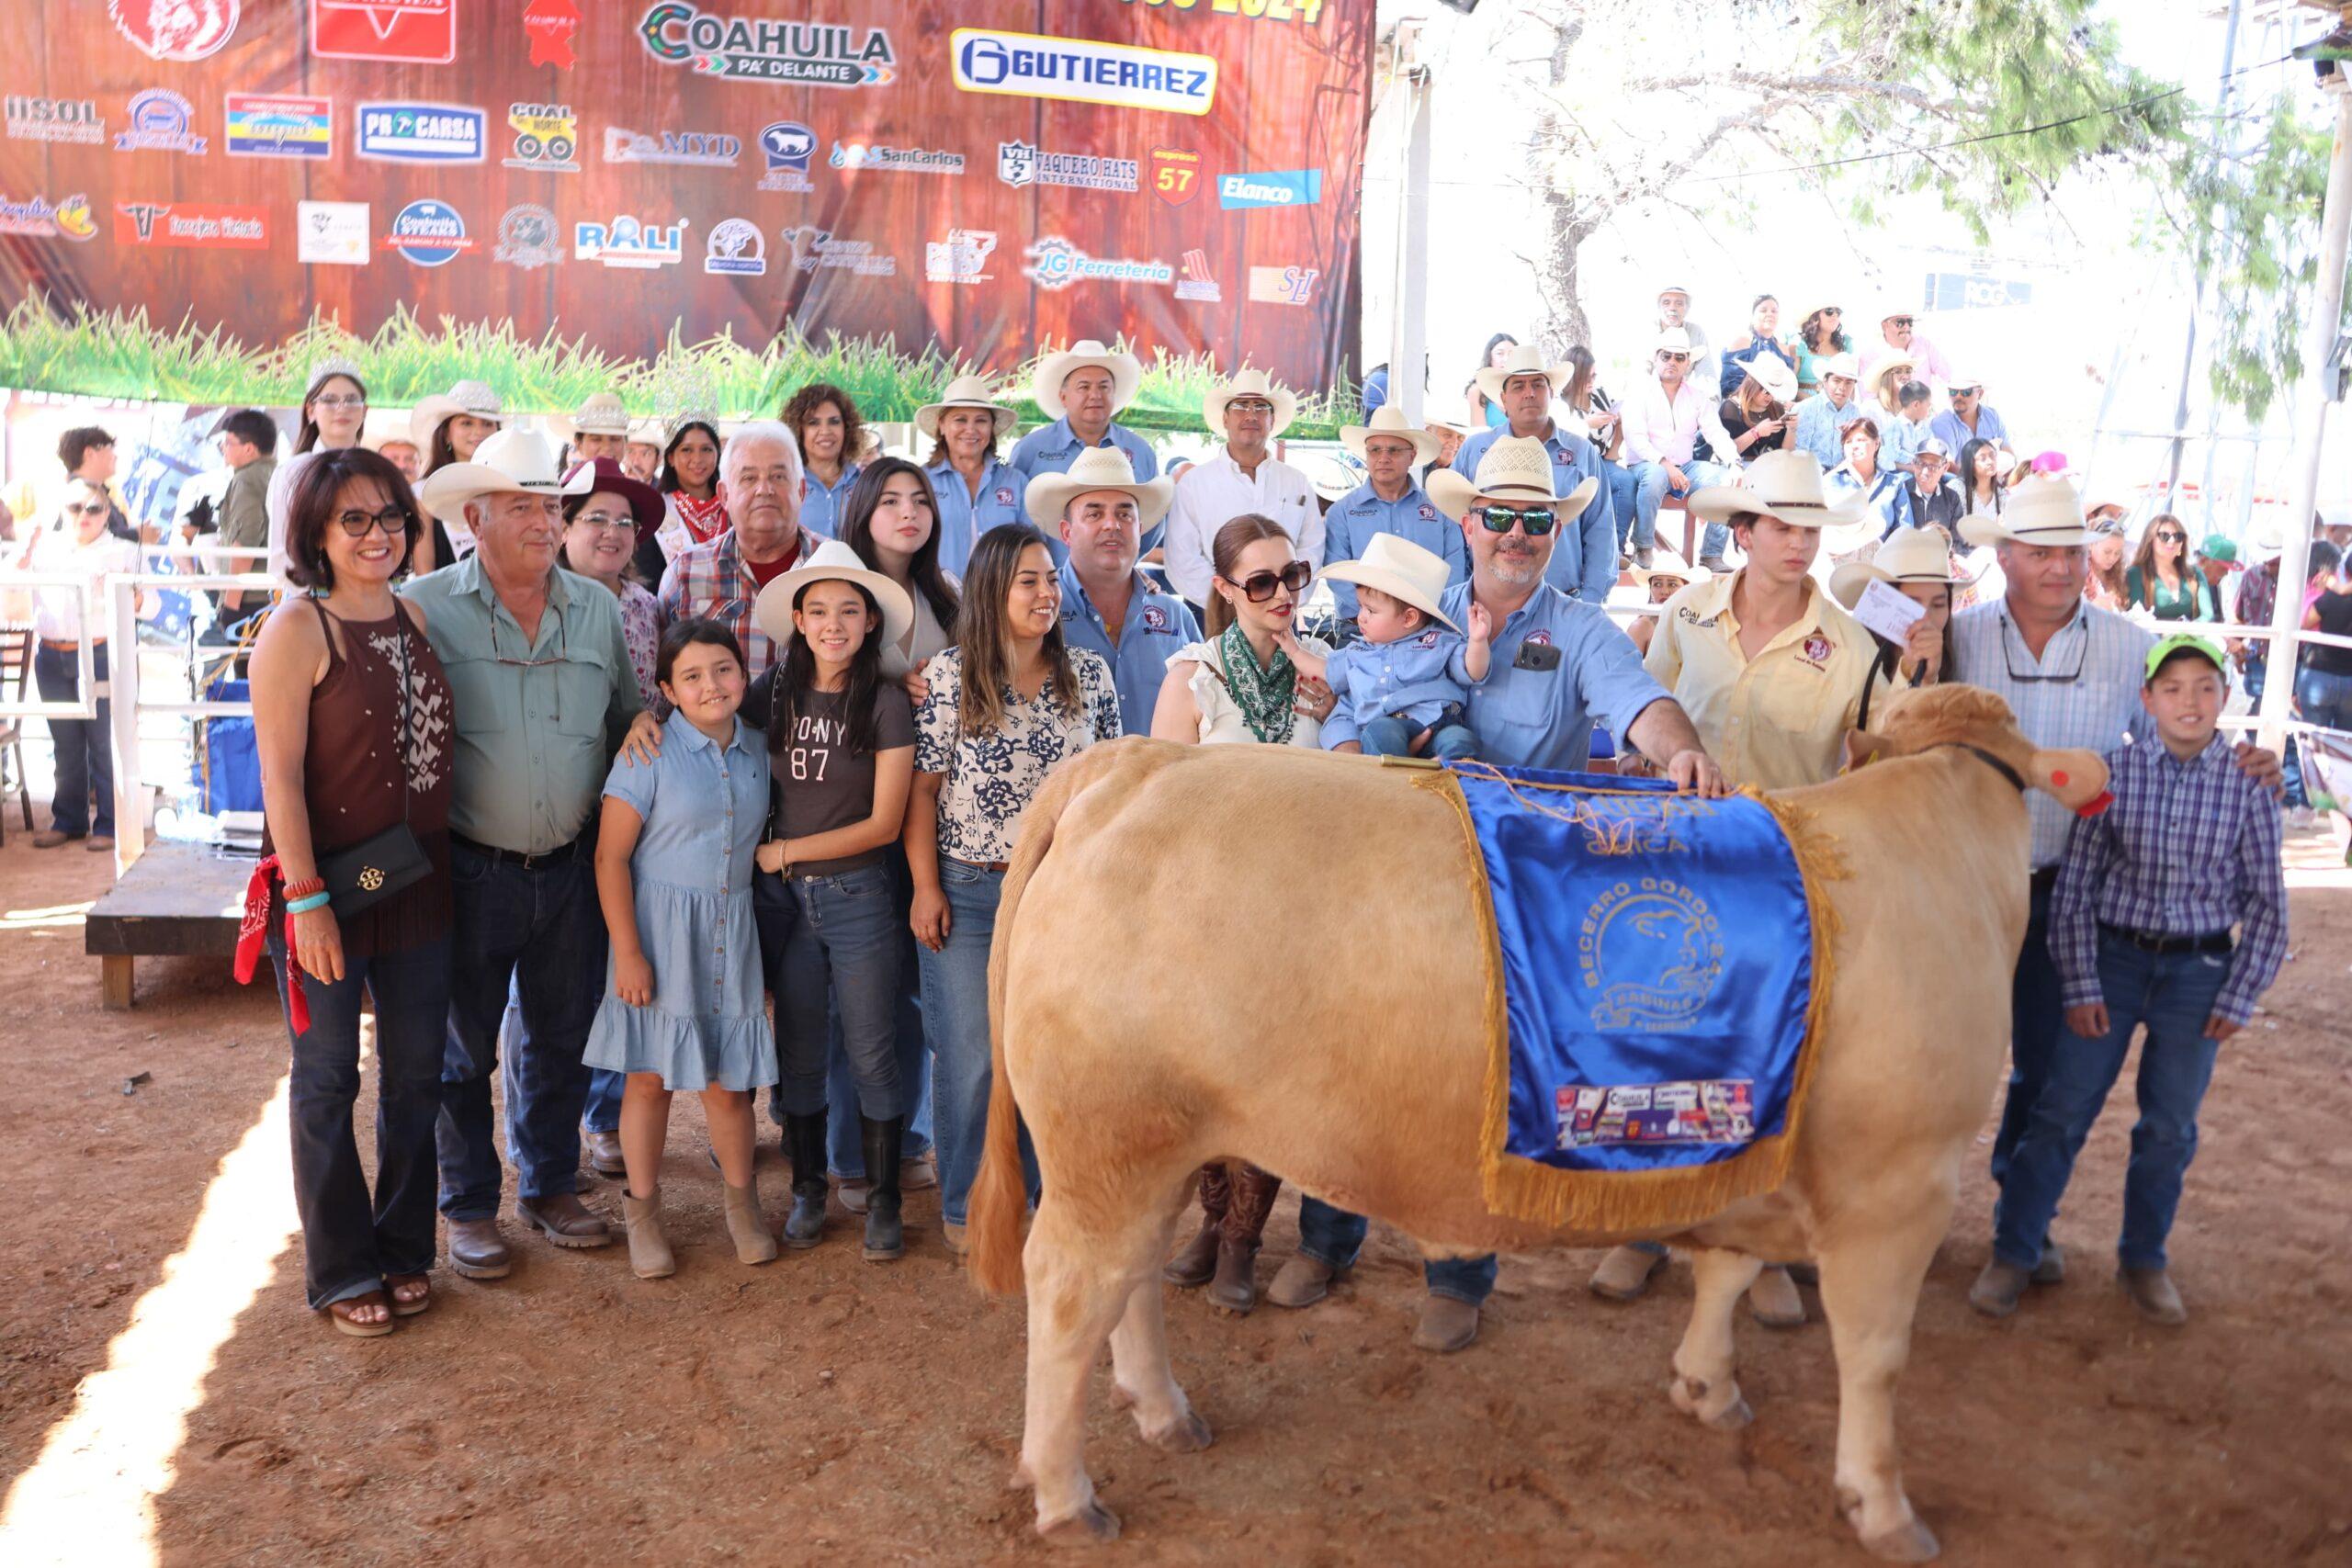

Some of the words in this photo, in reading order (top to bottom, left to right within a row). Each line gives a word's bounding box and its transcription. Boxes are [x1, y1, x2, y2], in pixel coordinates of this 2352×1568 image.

[642, 3, 896, 64] COAHUILA
[769, 62, 851, 82] DELANTE
[1012, 50, 1207, 97] GUTIERREZ
[1035, 152, 1099, 175] VAQUERO
[1102, 159, 1137, 180] HATS
[1157, 167, 1193, 192] 57
[1035, 173, 1138, 192] INTERNATIONAL
[1222, 176, 1294, 204] Elanco
[1039, 253, 1068, 274] JG
[791, 748, 829, 781] 87
[1578, 882, 1631, 989] BECERRO
[1640, 876, 1719, 932] GORDO
